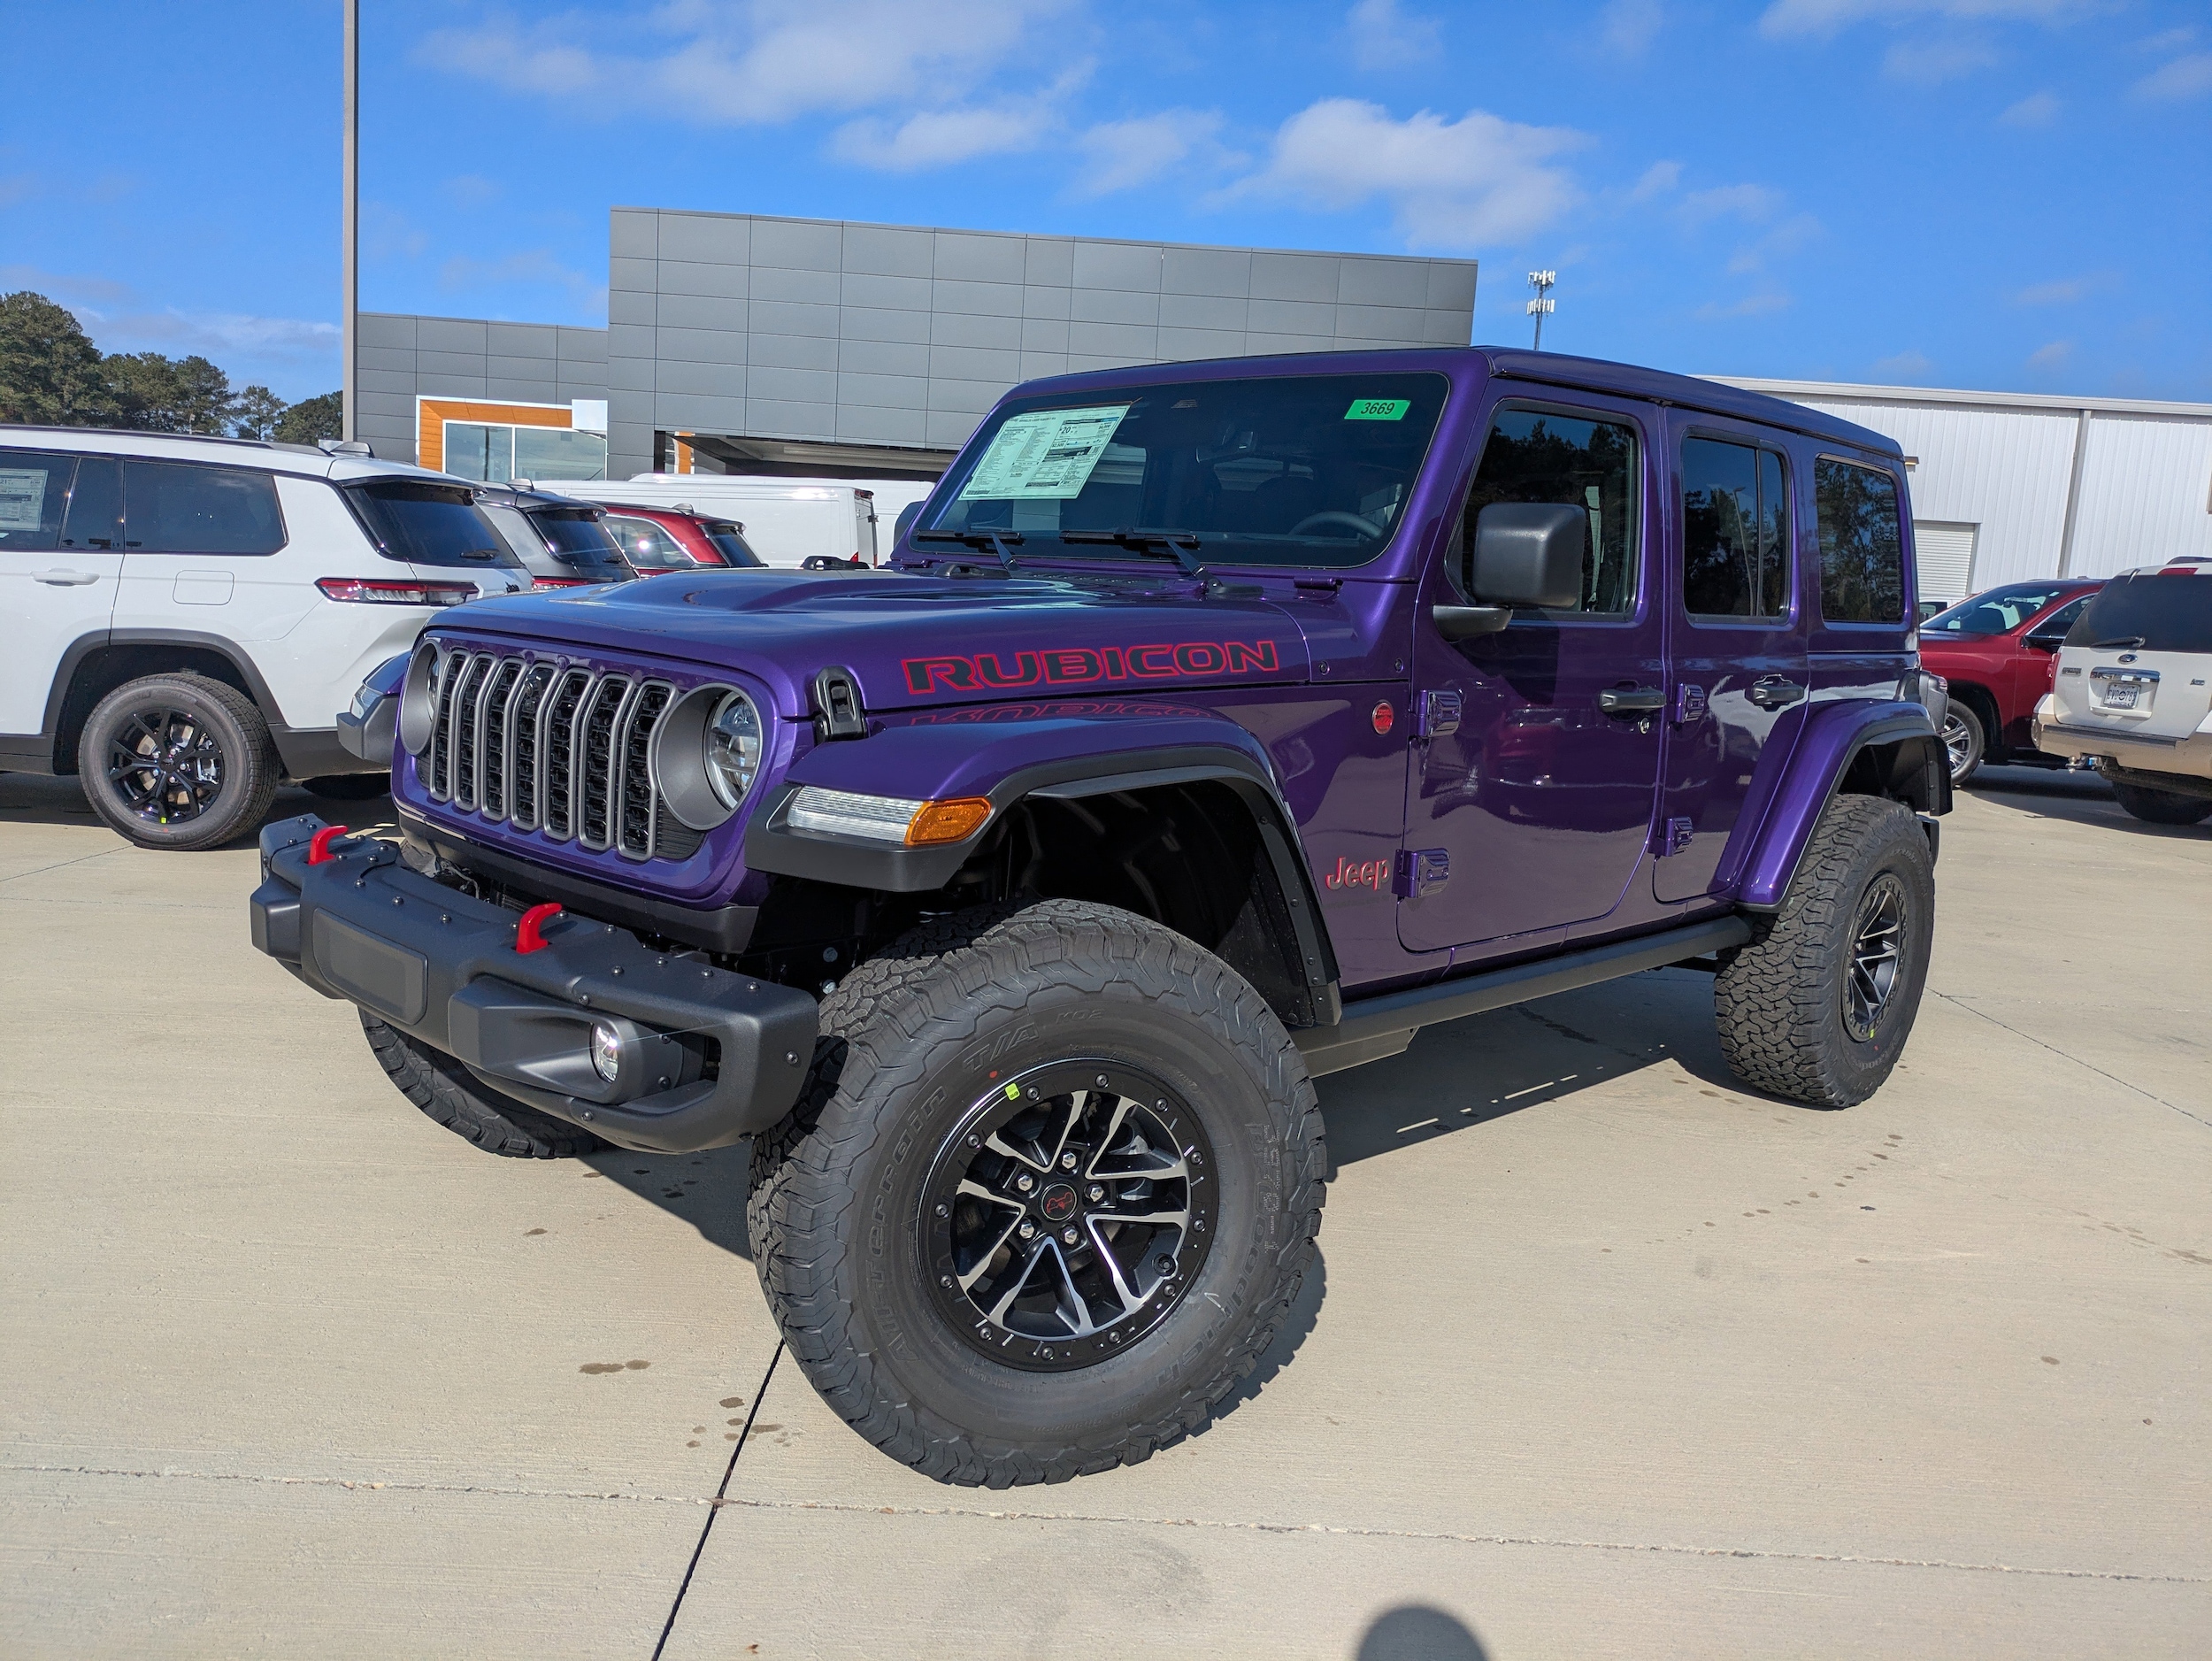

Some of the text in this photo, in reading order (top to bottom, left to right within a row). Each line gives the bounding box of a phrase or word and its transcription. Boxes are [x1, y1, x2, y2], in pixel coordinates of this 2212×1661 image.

[1360, 402, 1395, 415] 3669
[901, 640, 1280, 695] RUBICON
[1325, 856, 1392, 892] Jeep
